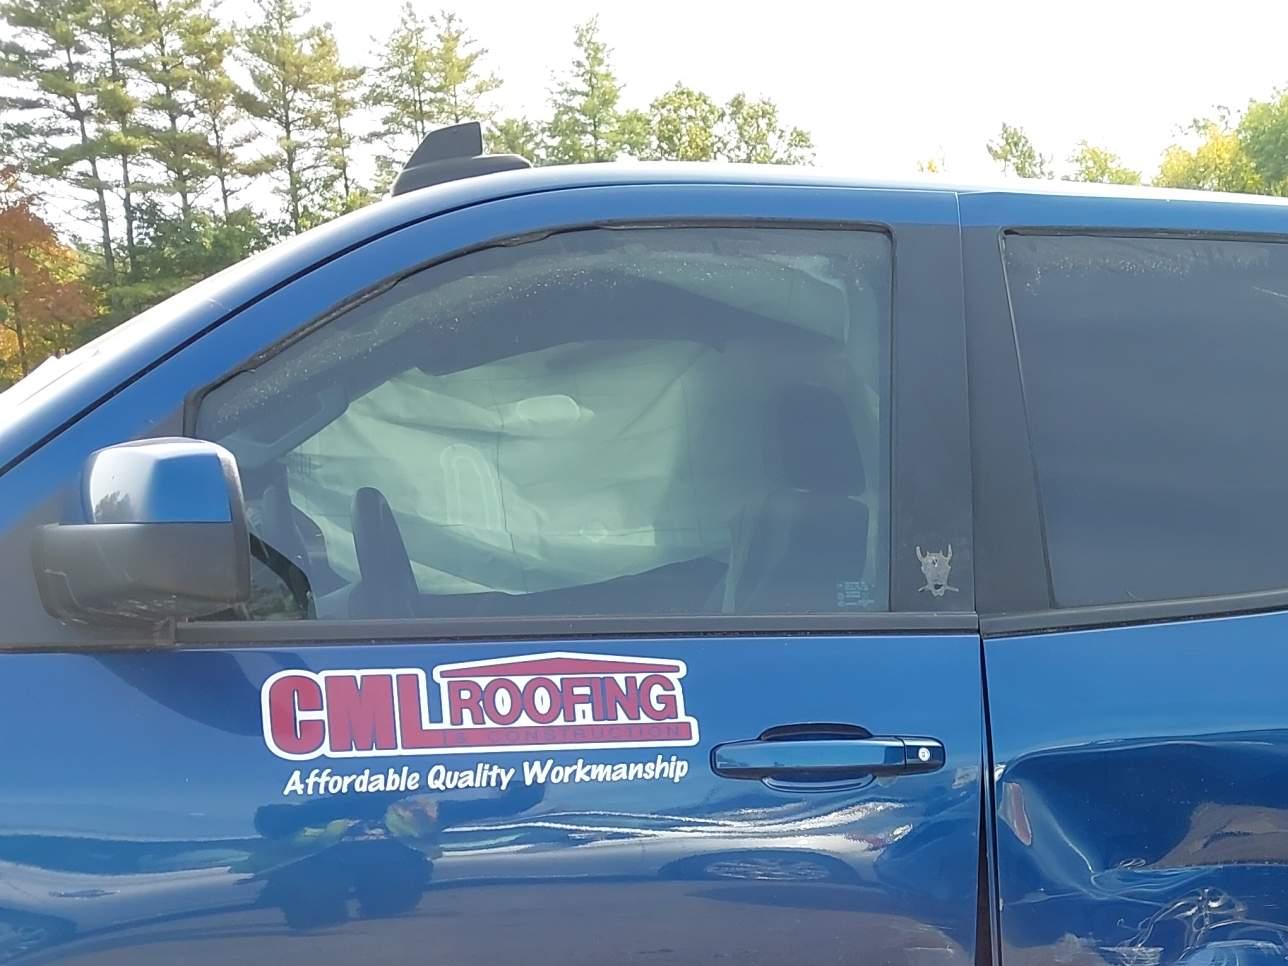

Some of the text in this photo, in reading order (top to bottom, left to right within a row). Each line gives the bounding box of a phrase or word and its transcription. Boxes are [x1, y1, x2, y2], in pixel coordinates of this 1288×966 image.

[266, 672, 679, 757] CML ROOFING
[283, 754, 689, 796] Affordable Quality Workmanship
